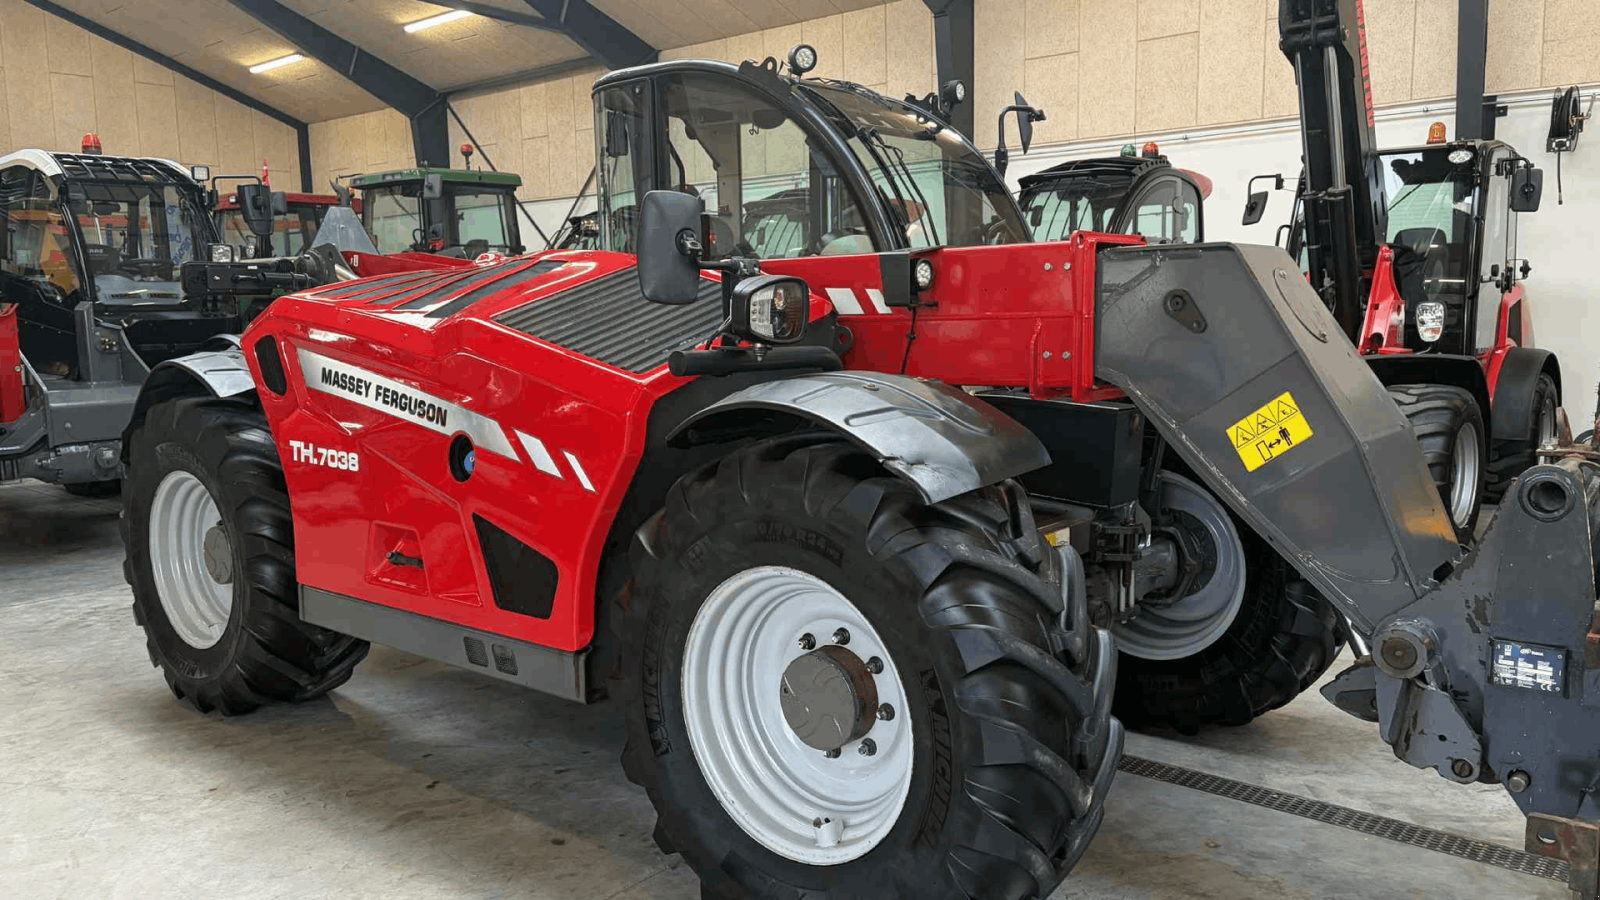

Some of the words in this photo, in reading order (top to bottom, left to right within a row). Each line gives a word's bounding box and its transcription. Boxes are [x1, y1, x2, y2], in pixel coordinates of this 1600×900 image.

[321, 366, 373, 398] MASSEY
[374, 384, 448, 427] FERGUSON
[289, 439, 359, 472] TH.7038
